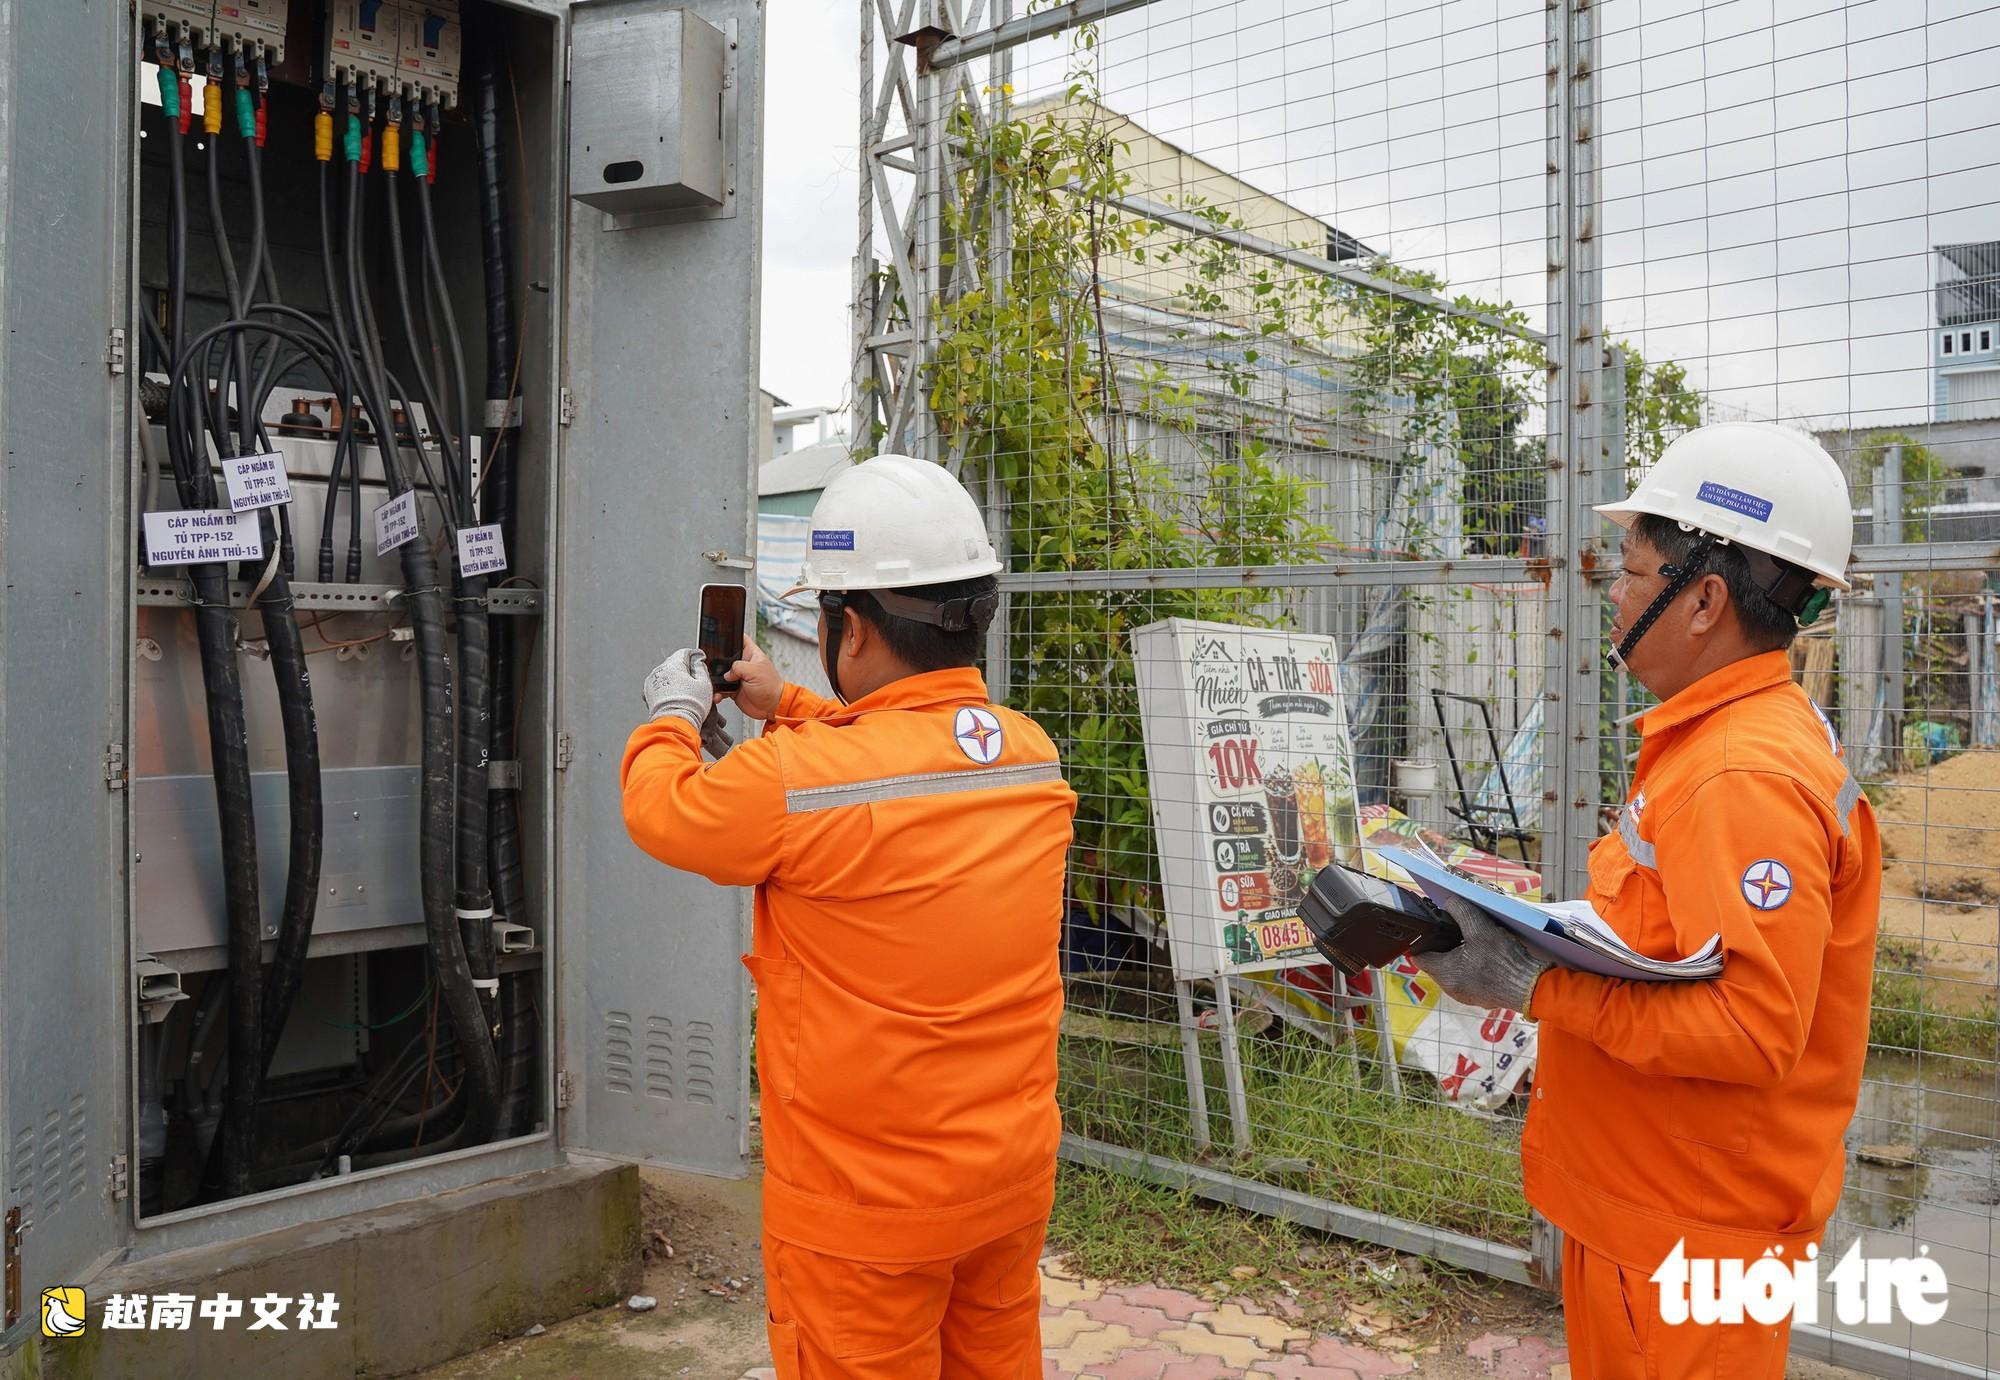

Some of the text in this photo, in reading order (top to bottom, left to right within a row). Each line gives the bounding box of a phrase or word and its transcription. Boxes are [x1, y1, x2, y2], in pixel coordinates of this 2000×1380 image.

[253, 476, 276, 488] TPP-152
[167, 515, 189, 528] CÁP
[226, 515, 237, 525] ĐI
[174, 531, 233, 544] TỦ TPP-152
[152, 543, 258, 562] NGUYỄN ẢNH THỦ-15
[475, 545, 493, 556] TPP-152
[1247, 648, 1269, 693] CÀ
[1308, 656, 1334, 696] SỮA
[1195, 675, 1249, 712] Nhiên
[1210, 723, 1225, 736] GIÁ
[1225, 720, 1239, 733] CHỈ
[1208, 739, 1262, 789] 10K
[1231, 803, 1256, 818] CÀ PHÊ
[1235, 839, 1251, 854] TRÀ
[1240, 875, 1256, 889] SỮA
[1264, 910, 1280, 920] GIAO
[1262, 922, 1300, 949] 0845
